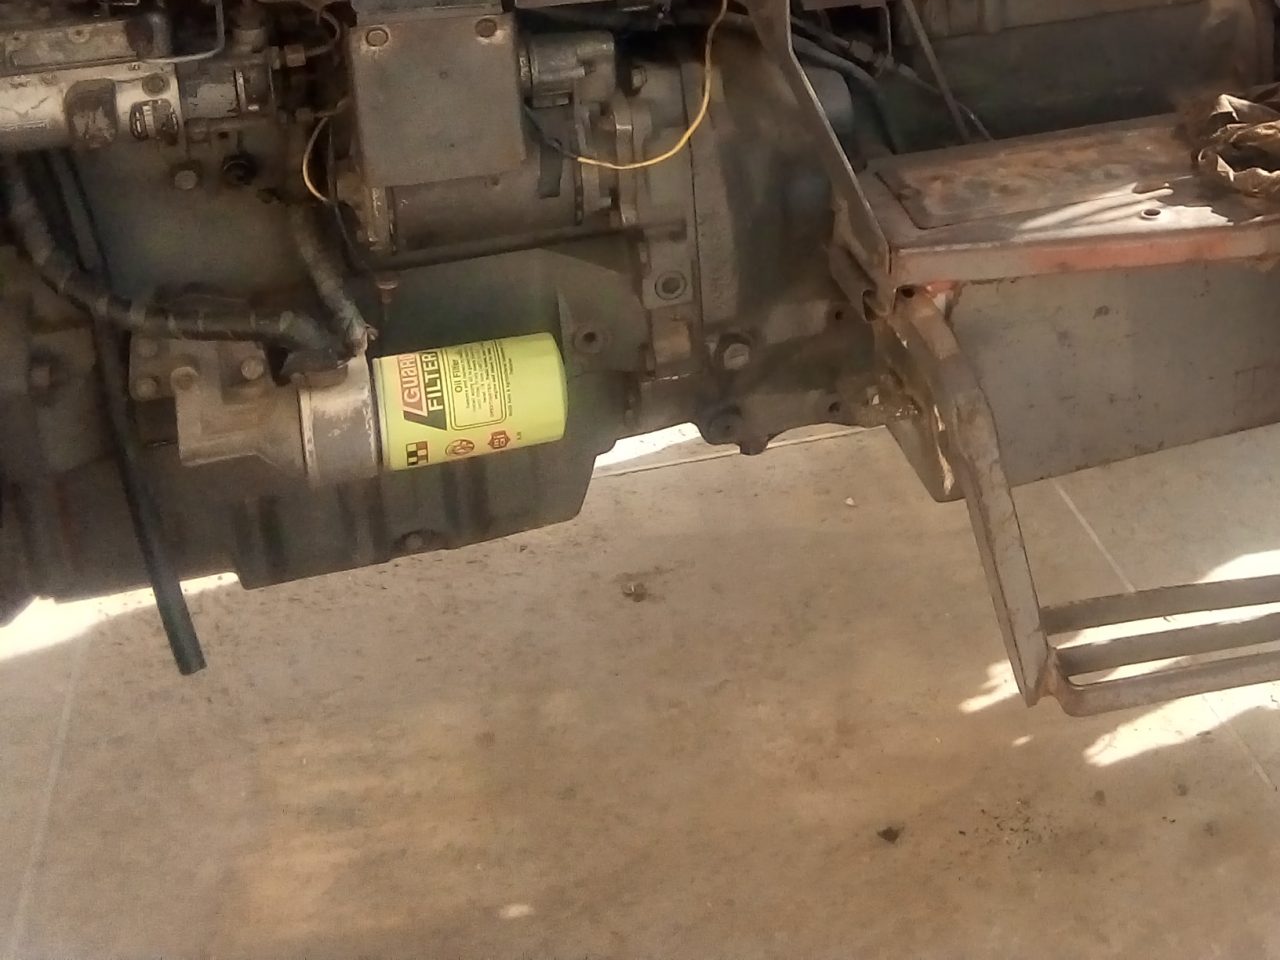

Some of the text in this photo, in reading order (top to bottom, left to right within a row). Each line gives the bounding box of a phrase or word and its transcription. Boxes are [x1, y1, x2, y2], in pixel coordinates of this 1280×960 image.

[421, 352, 444, 411] FILTER
[452, 359, 463, 393] Oil Filter
